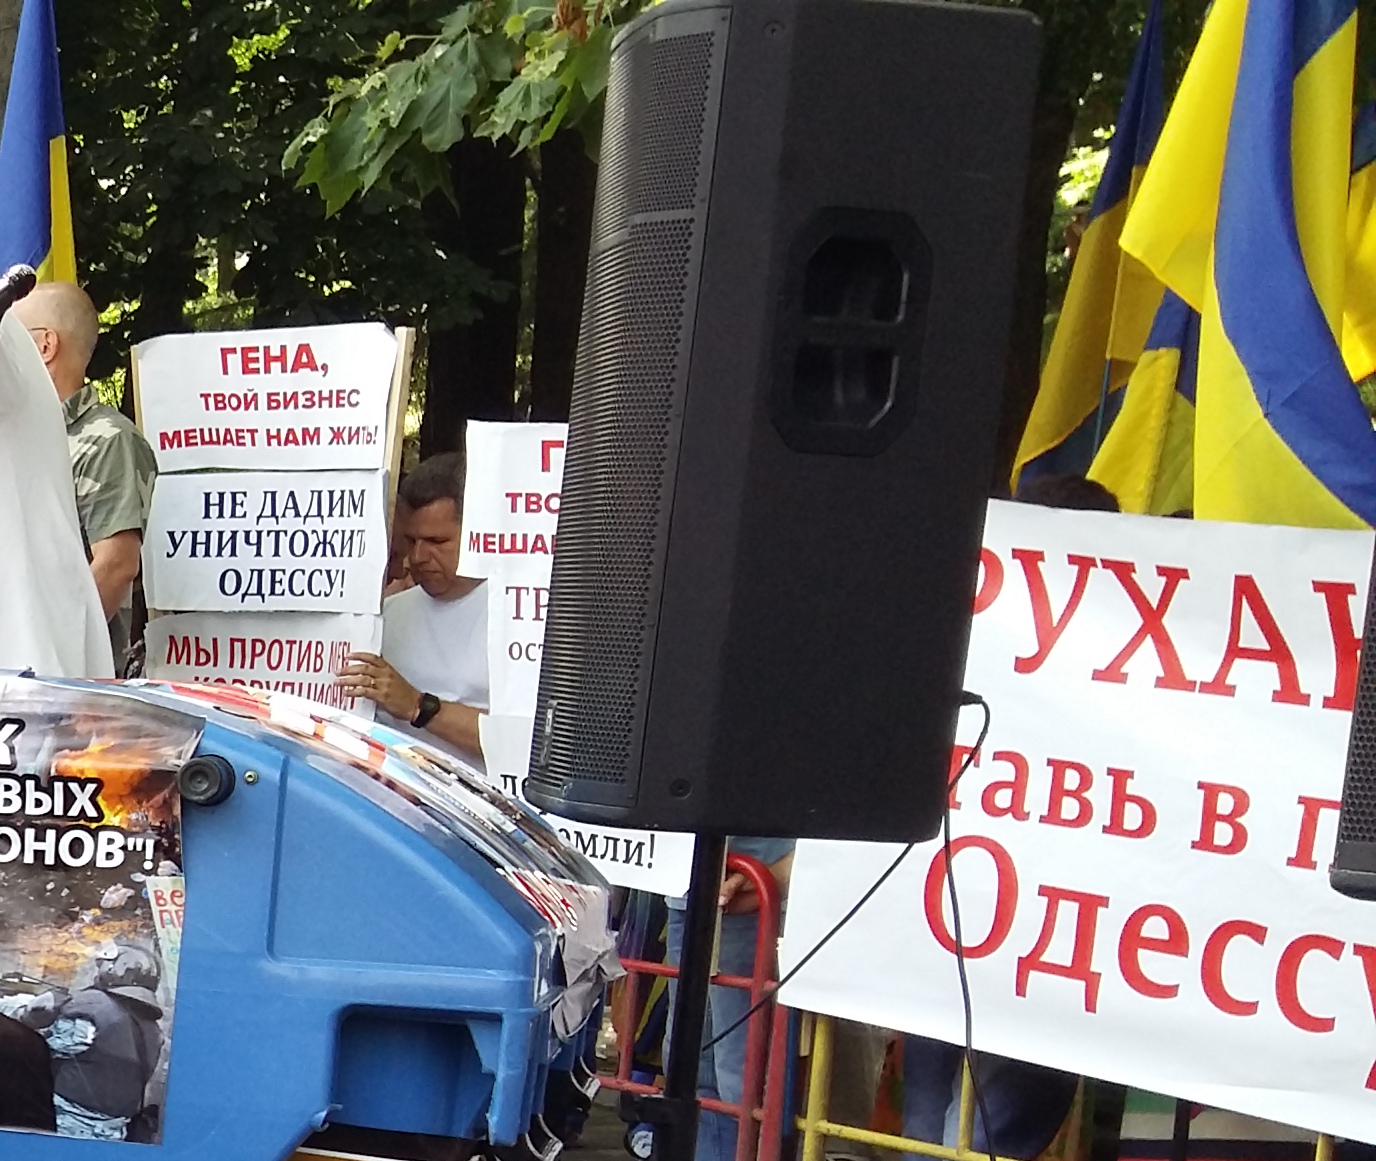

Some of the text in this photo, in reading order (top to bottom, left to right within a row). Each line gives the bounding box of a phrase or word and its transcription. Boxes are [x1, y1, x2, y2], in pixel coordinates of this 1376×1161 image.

[219, 343, 329, 377] ГЕНА,
[199, 388, 361, 412] ТВОЙ БИЗНЕС
[159, 425, 378, 451] МЕШАЕТ НАМ ЖИТЬ!
[201, 488, 366, 526] НЕ ДАДИМ
[218, 568, 345, 603] ОДЕССУ!
[166, 635, 219, 668] МЫ
[228, 637, 325, 674] ПРОТИВ
[508, 641, 545, 662] ос
[1190, 780, 1252, 856] в
